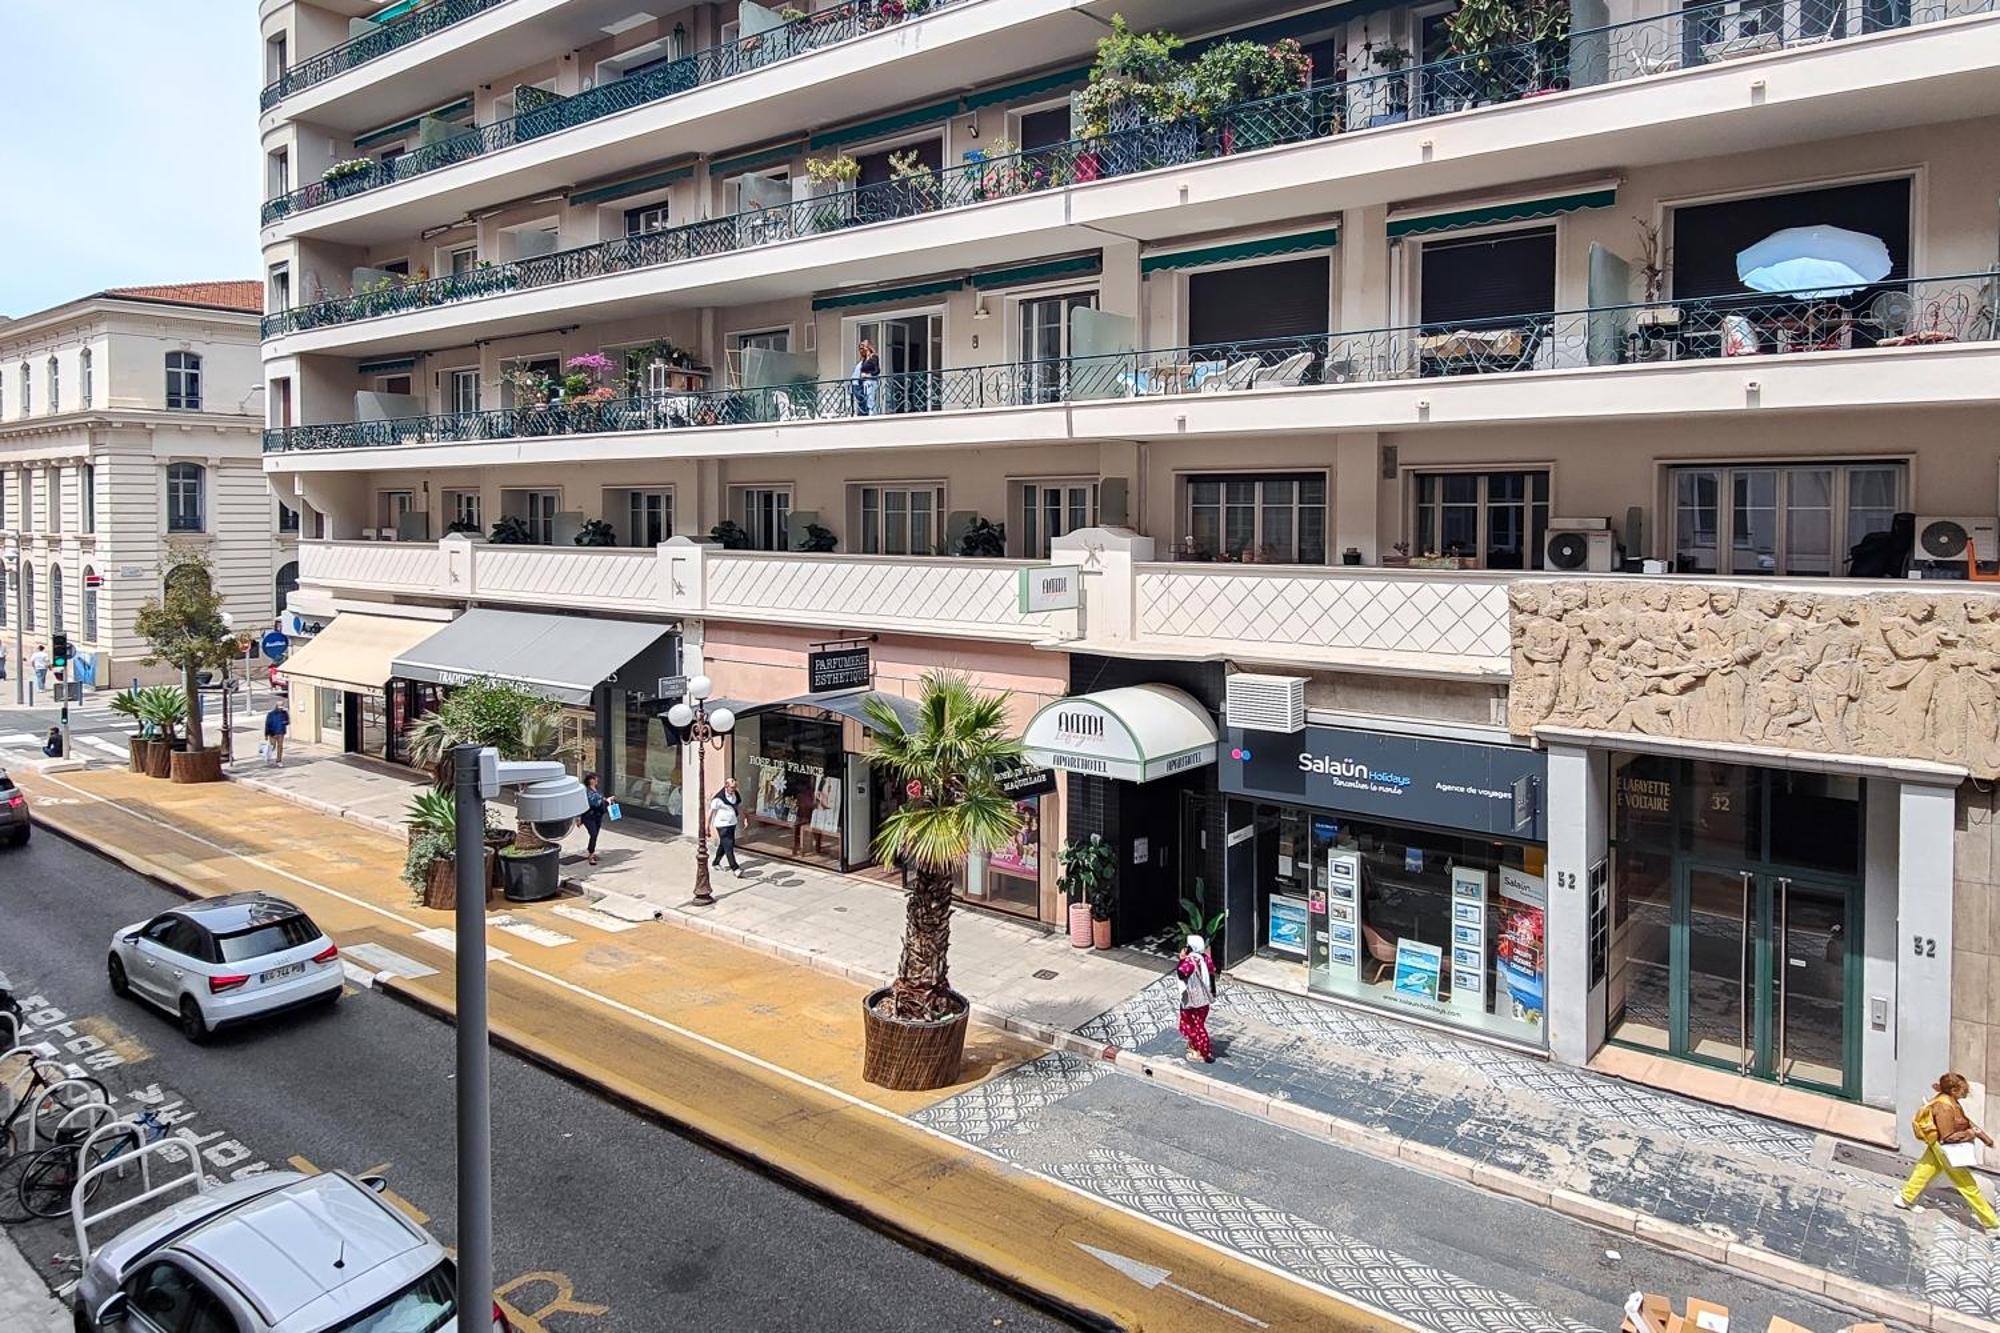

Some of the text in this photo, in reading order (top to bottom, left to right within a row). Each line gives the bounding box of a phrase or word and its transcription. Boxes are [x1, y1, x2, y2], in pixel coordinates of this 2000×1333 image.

[815, 654, 868, 671] PARFUMERIE
[749, 755, 824, 777] ROSE DE FRANCE
[1053, 755, 1107, 773] APARTHOTEL
[1298, 753, 1411, 786] Salaün Holidays
[1004, 774, 1047, 791] MAQUILLAGE
[1436, 782, 1512, 800] Agence de voyages
[1623, 778, 1671, 797] LAFAYETTE
[1625, 793, 1670, 812] VOLTAIRE
